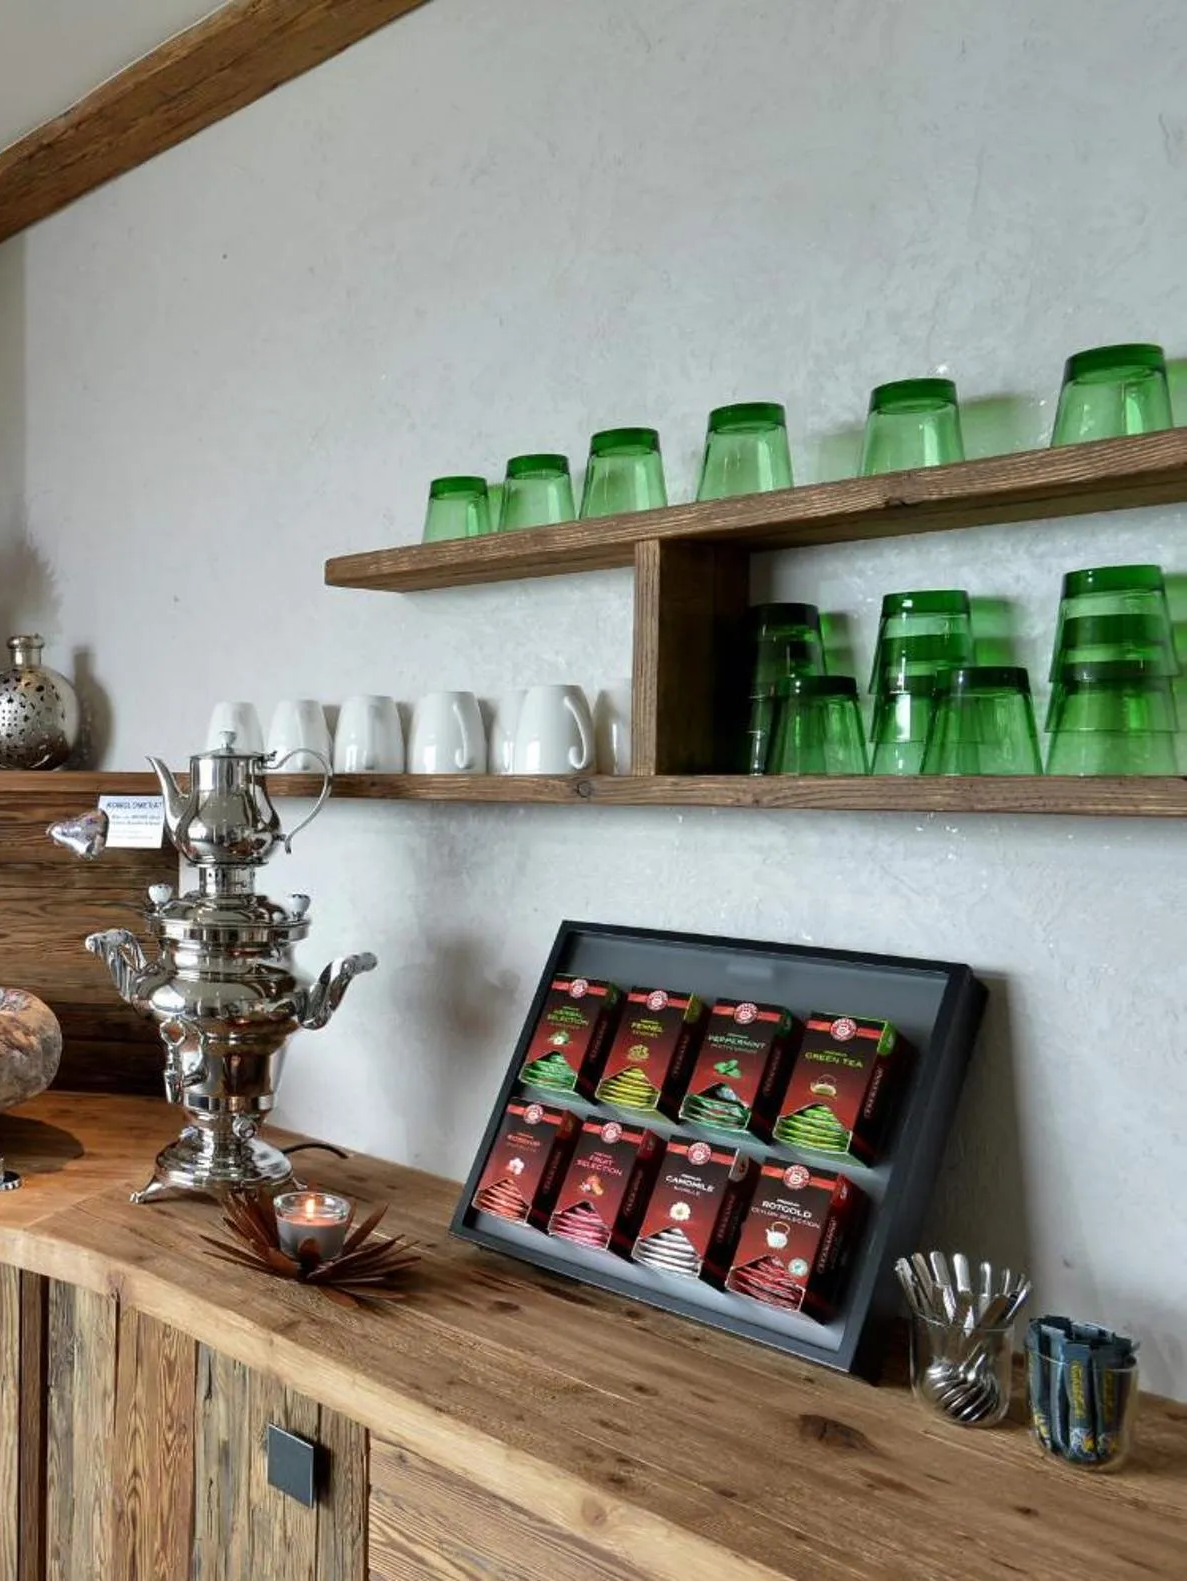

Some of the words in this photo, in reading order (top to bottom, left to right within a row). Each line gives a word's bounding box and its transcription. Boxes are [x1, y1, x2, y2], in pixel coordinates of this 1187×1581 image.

[708, 1034, 767, 1050] PEPPERMINT
[805, 1051, 840, 1064] GREEN
[842, 1057, 864, 1069] TEA
[575, 1159, 623, 1177] SELECTION
[589, 1154, 614, 1166] FRUIT
[665, 1175, 715, 1193] CAMOMILE
[762, 1200, 812, 1219] ROTGOLD
